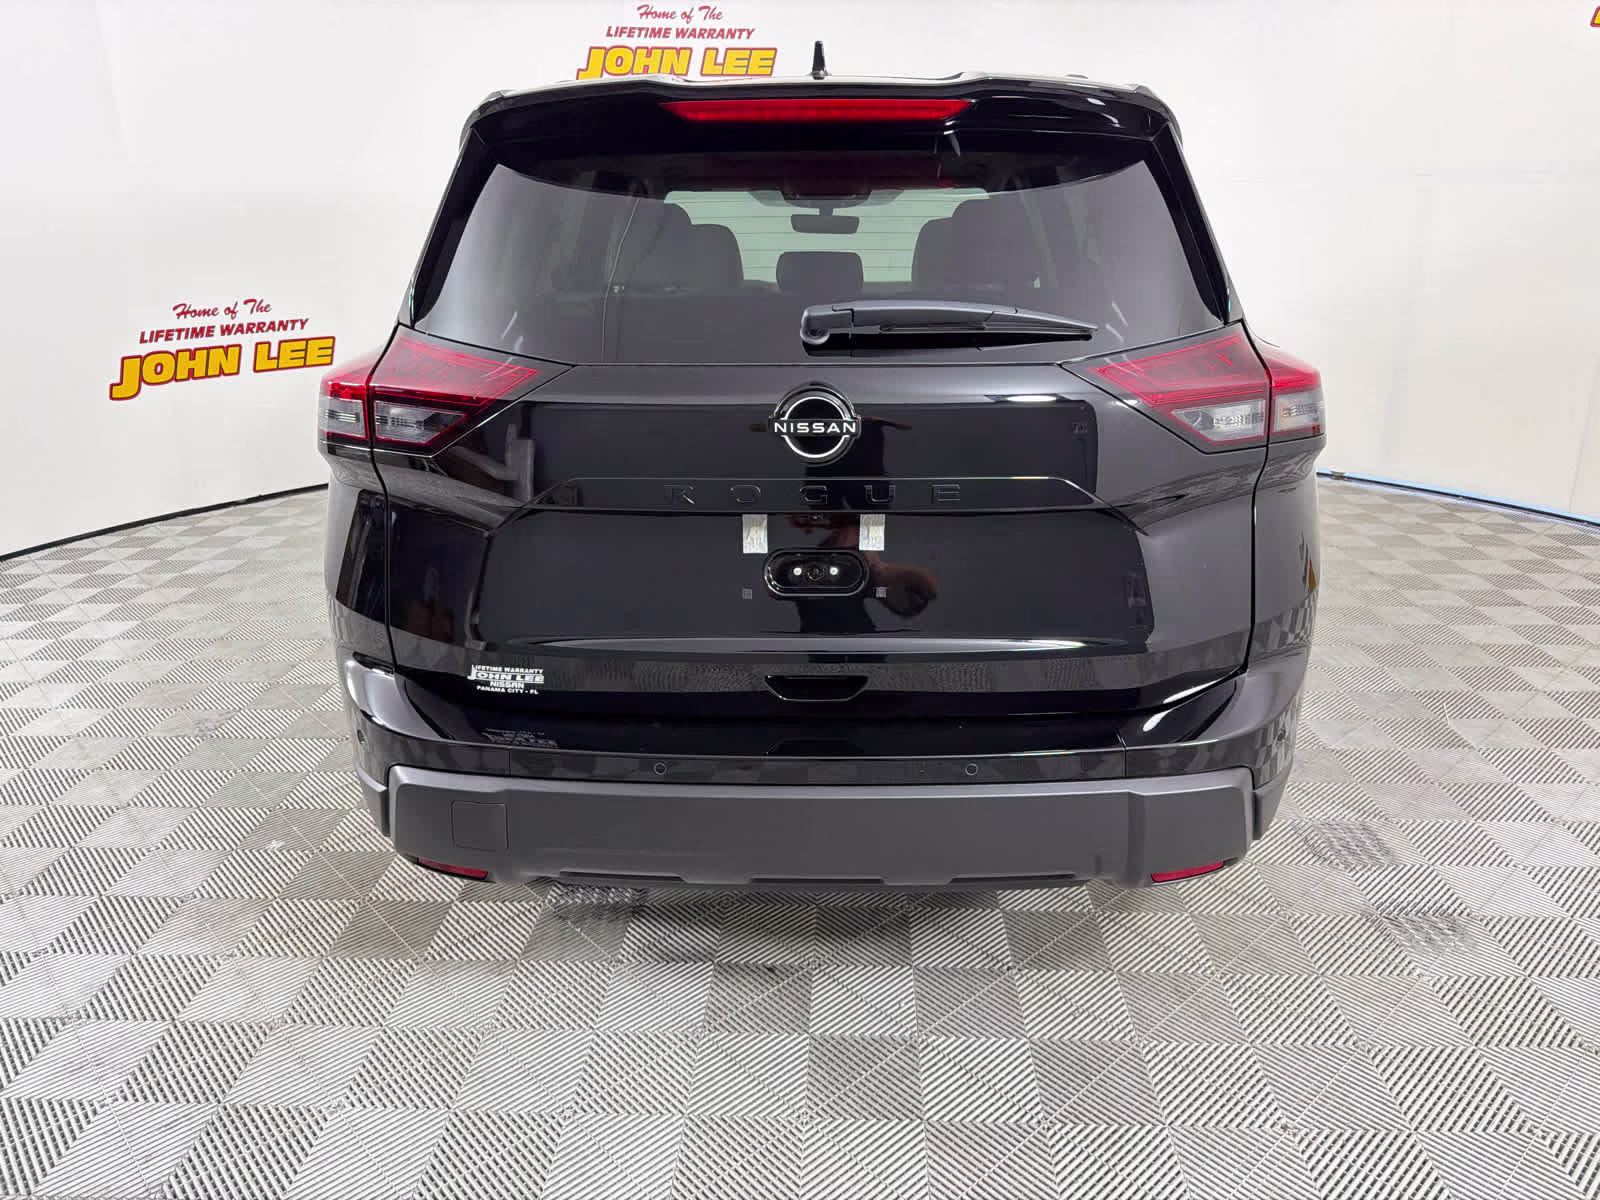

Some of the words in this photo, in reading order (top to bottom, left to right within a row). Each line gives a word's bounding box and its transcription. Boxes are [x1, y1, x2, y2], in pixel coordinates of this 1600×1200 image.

[637, 4, 676, 20] Home
[680, 7, 694, 24] of
[698, 5, 723, 21] The
[606, 26, 672, 38] LIFETIME
[675, 27, 755, 39] WARRANTY
[576, 45, 693, 80] JOHN
[700, 47, 777, 76] LEE
[172, 303, 220, 319] Home
[223, 302, 238, 320] of
[243, 299, 272, 314] The
[139, 325, 215, 344] LIFETIME
[220, 318, 309, 336] WARRANTY
[109, 344, 242, 400] JOHN
[253, 336, 335, 372] LEE
[774, 422, 856, 433] NISSAN
[664, 484, 961, 504] ROGUE
[467, 668, 512, 680] JOHN
[515, 674, 544, 682] LEE
[490, 680, 525, 689] NISSAN
[476, 685, 506, 693] PANAMA
